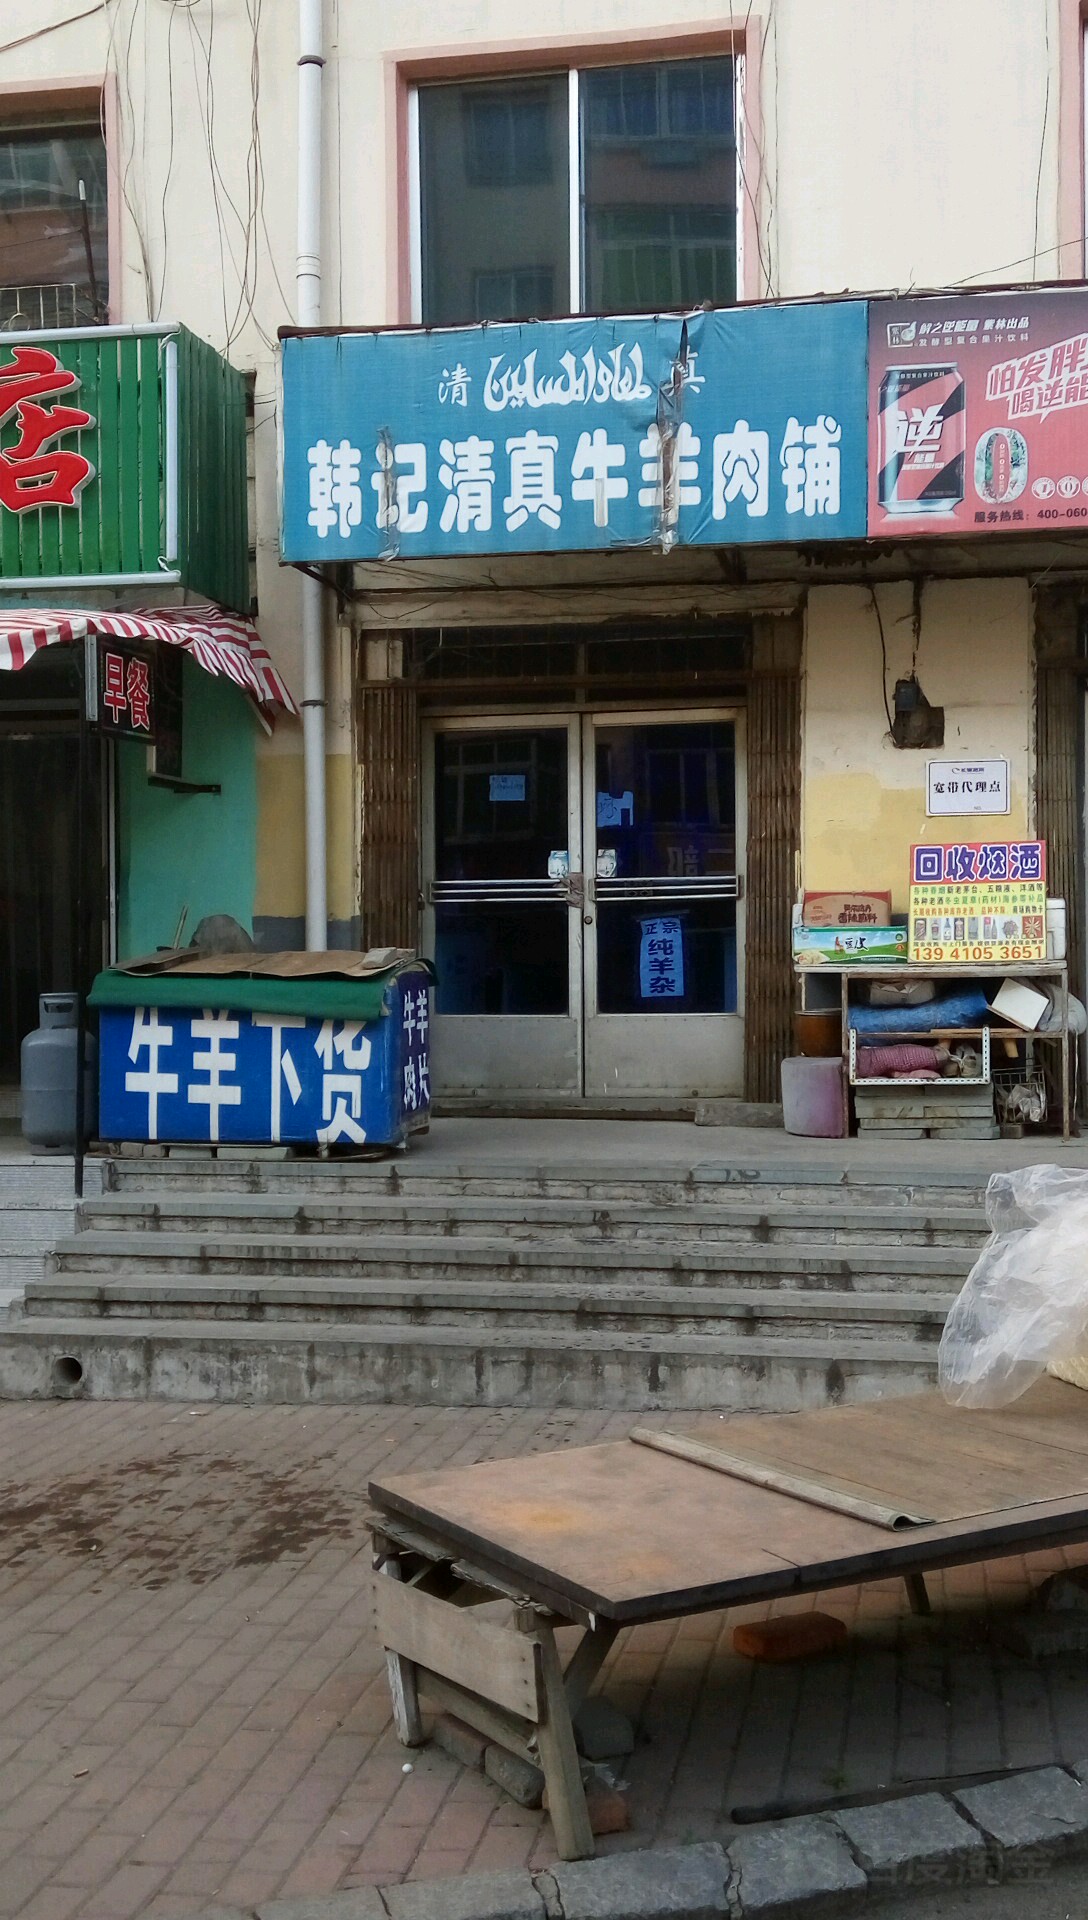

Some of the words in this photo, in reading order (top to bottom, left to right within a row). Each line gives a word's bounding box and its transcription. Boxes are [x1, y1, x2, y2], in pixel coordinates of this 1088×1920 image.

[438, 363, 472, 406] 清
[663, 345, 706, 397] 真
[307, 415, 842, 538] 韩记清真牛羊肉铺
[103, 652, 150, 731] 早餐
[933, 781, 1001, 794] 宽带代理点
[914, 842, 1042, 882] 回收烟酒
[645, 921, 679, 935] 正宗
[845, 936, 870, 951] 豆皮
[913, 947, 944, 960] 139
[950, 947, 994, 960] 4105
[1000, 946, 1042, 960] 3651
[647, 938, 676, 994] 纯羊杂
[403, 989, 429, 1046] 牛羊
[125, 1007, 372, 1145] 牛羊下货
[403, 1053, 430, 1111] 肉片
